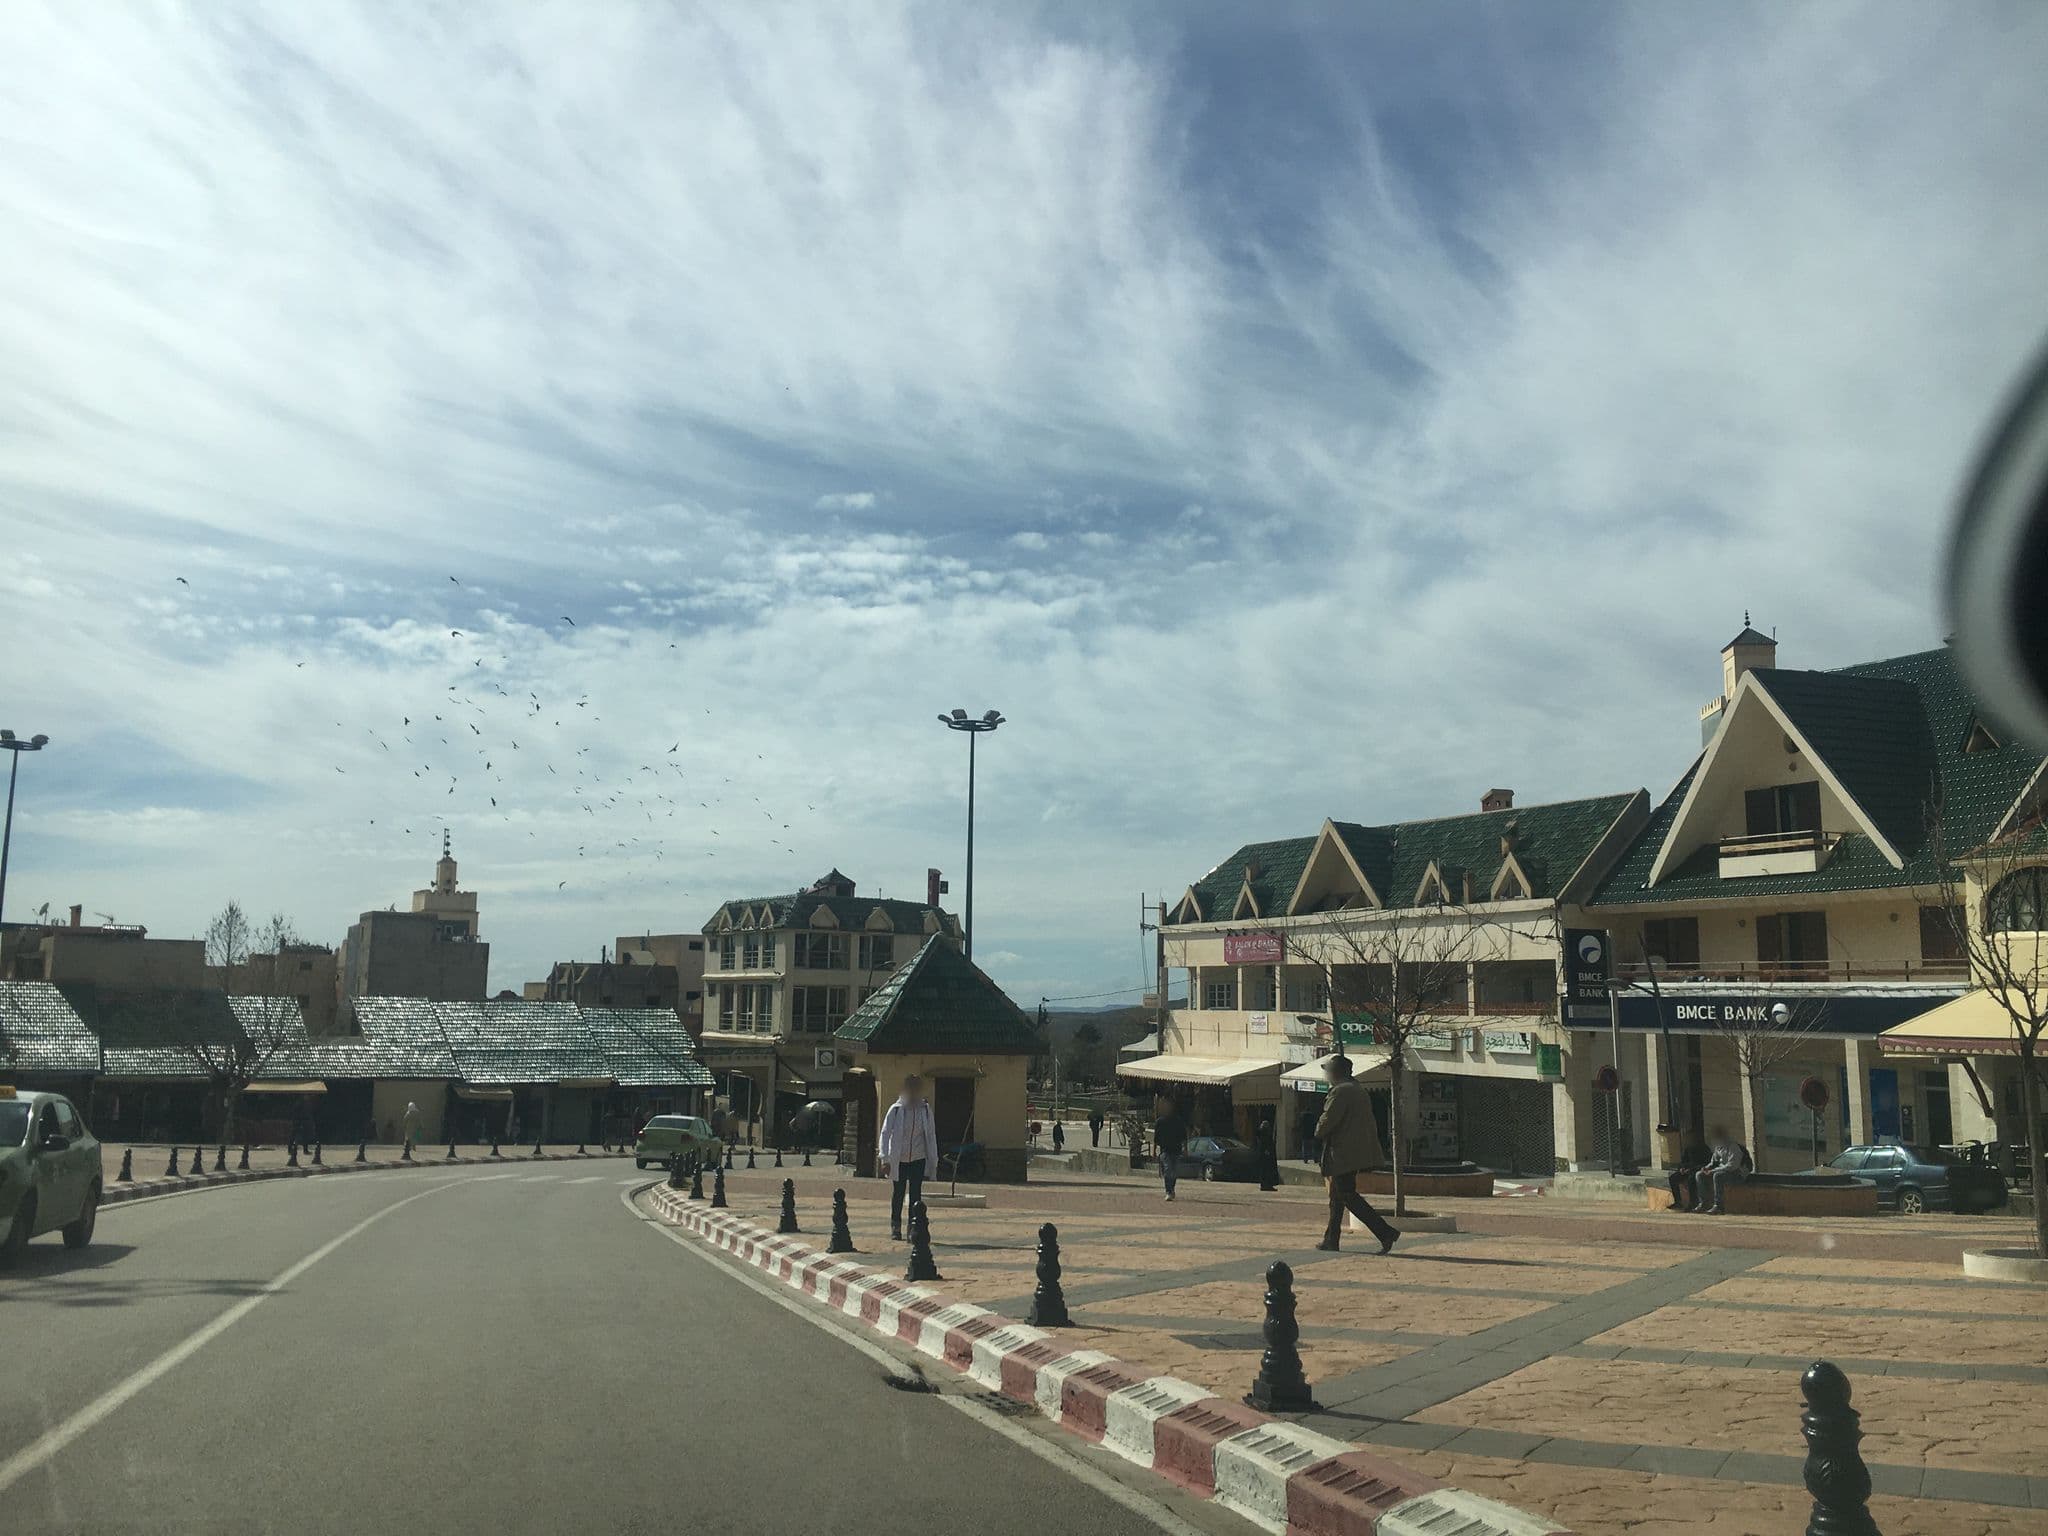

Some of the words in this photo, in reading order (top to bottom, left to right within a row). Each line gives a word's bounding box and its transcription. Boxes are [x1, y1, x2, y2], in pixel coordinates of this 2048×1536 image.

[1578, 972, 1603, 982] BMCE
[1579, 988, 1604, 998] BANK
[1676, 1005, 1717, 1020] BMCE
[1724, 1005, 1768, 1021] BANK
